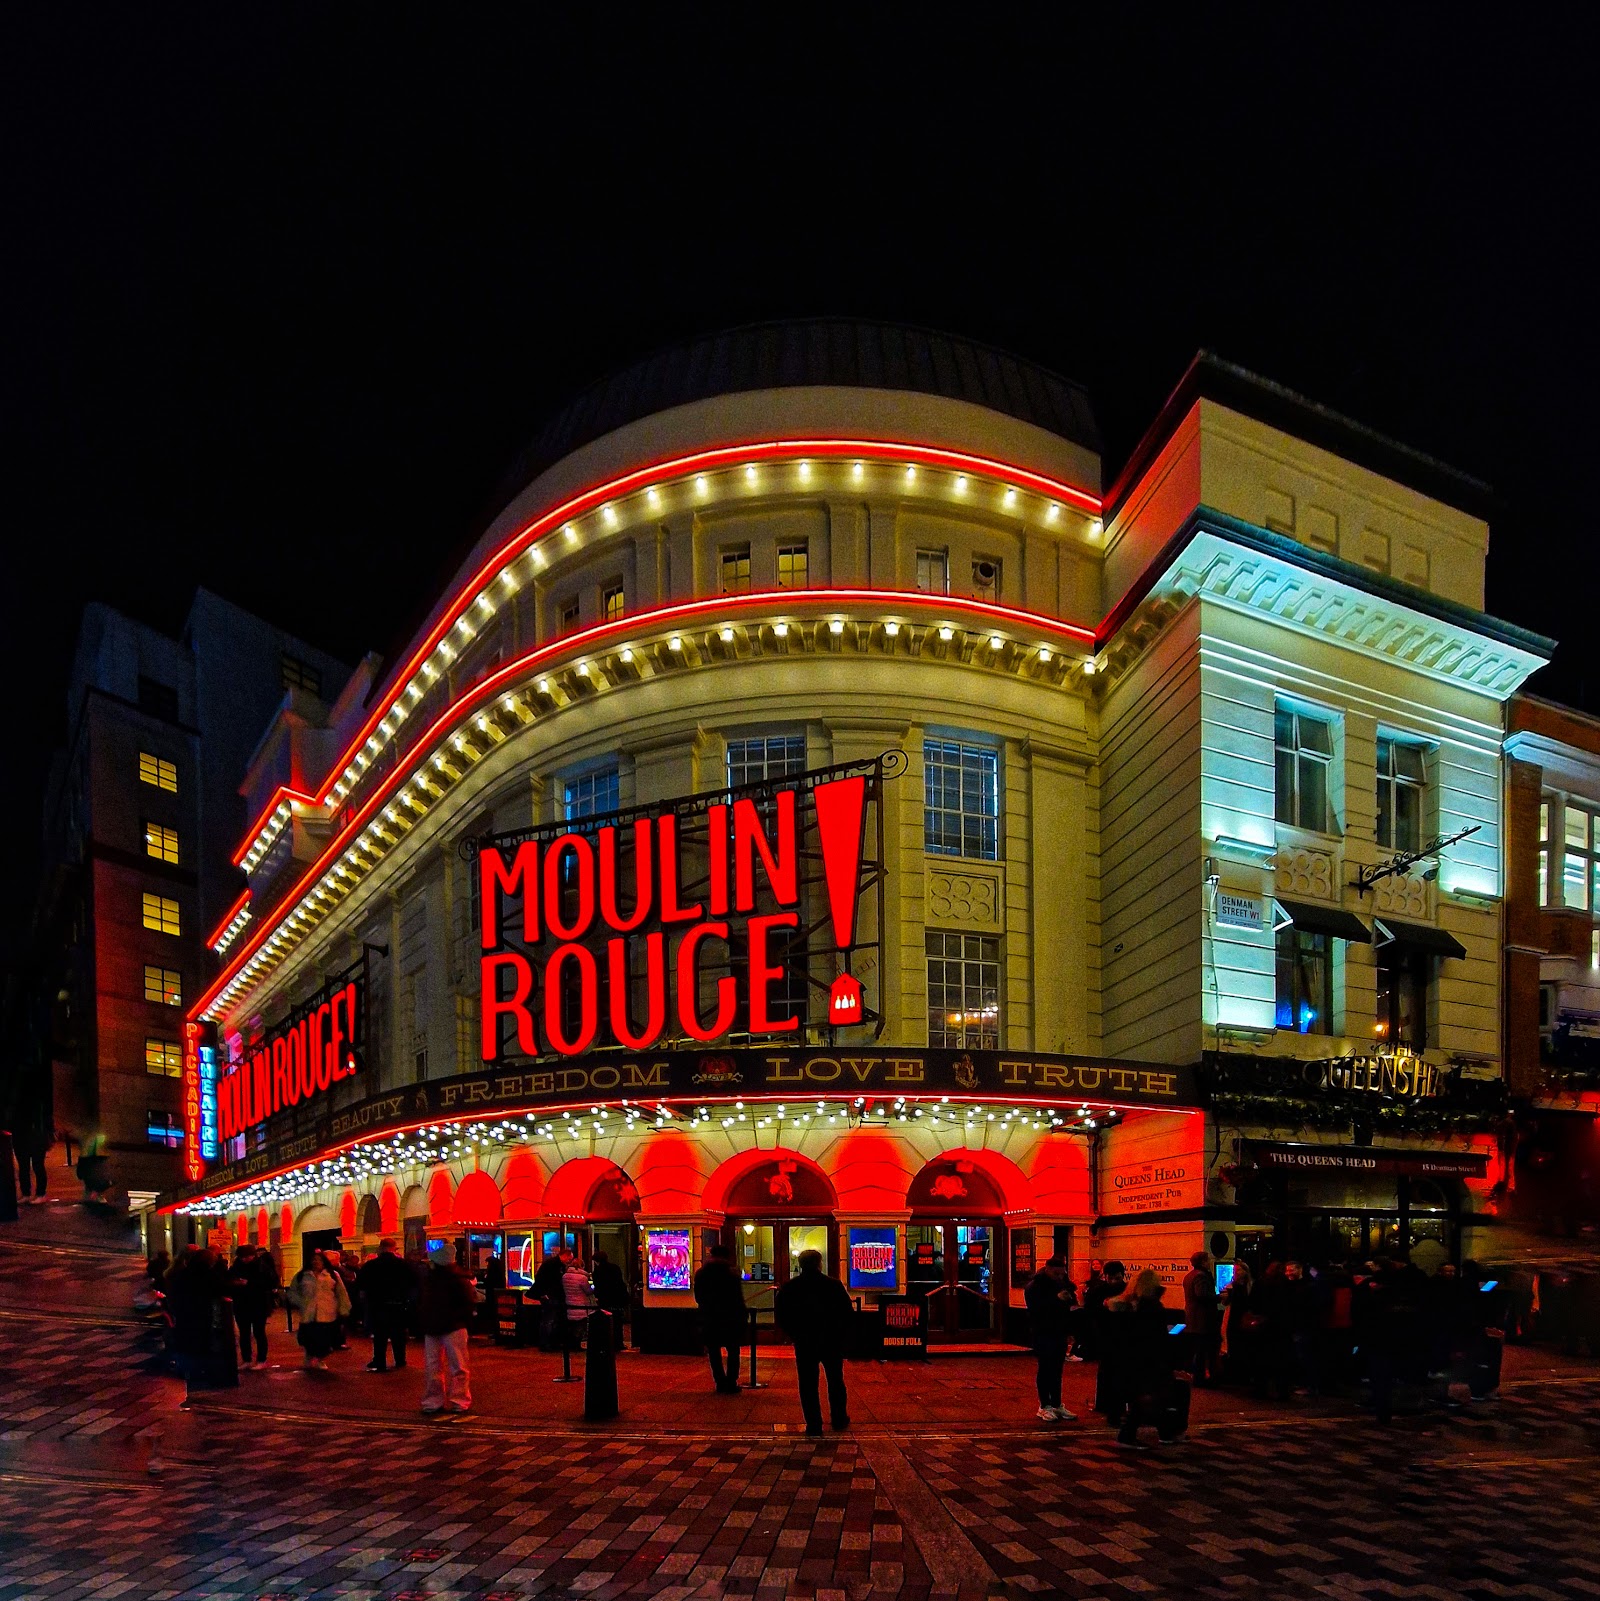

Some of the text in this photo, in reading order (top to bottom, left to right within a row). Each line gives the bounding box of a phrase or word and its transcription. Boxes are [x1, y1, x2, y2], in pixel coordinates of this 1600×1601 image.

[479, 790, 798, 949] MOULIN
[1221, 896, 1253, 909] DENMAN
[1222, 906, 1260, 920] STREET W1
[186, 1022, 200, 1181] PICCADILLY
[200, 1046, 216, 1158] THEATRE
[217, 1046, 271, 1144] MOULIN
[331, 1095, 405, 1135] BEAUTY
[440, 1062, 670, 1107] FREEDOM
[765, 1057, 925, 1082] LOVE
[998, 1061, 1178, 1096] TRUTH
[1114, 1167, 1185, 1188] QUEENS HEAD
[1270, 1152, 1376, 1169] THE QUEENS HEAD
